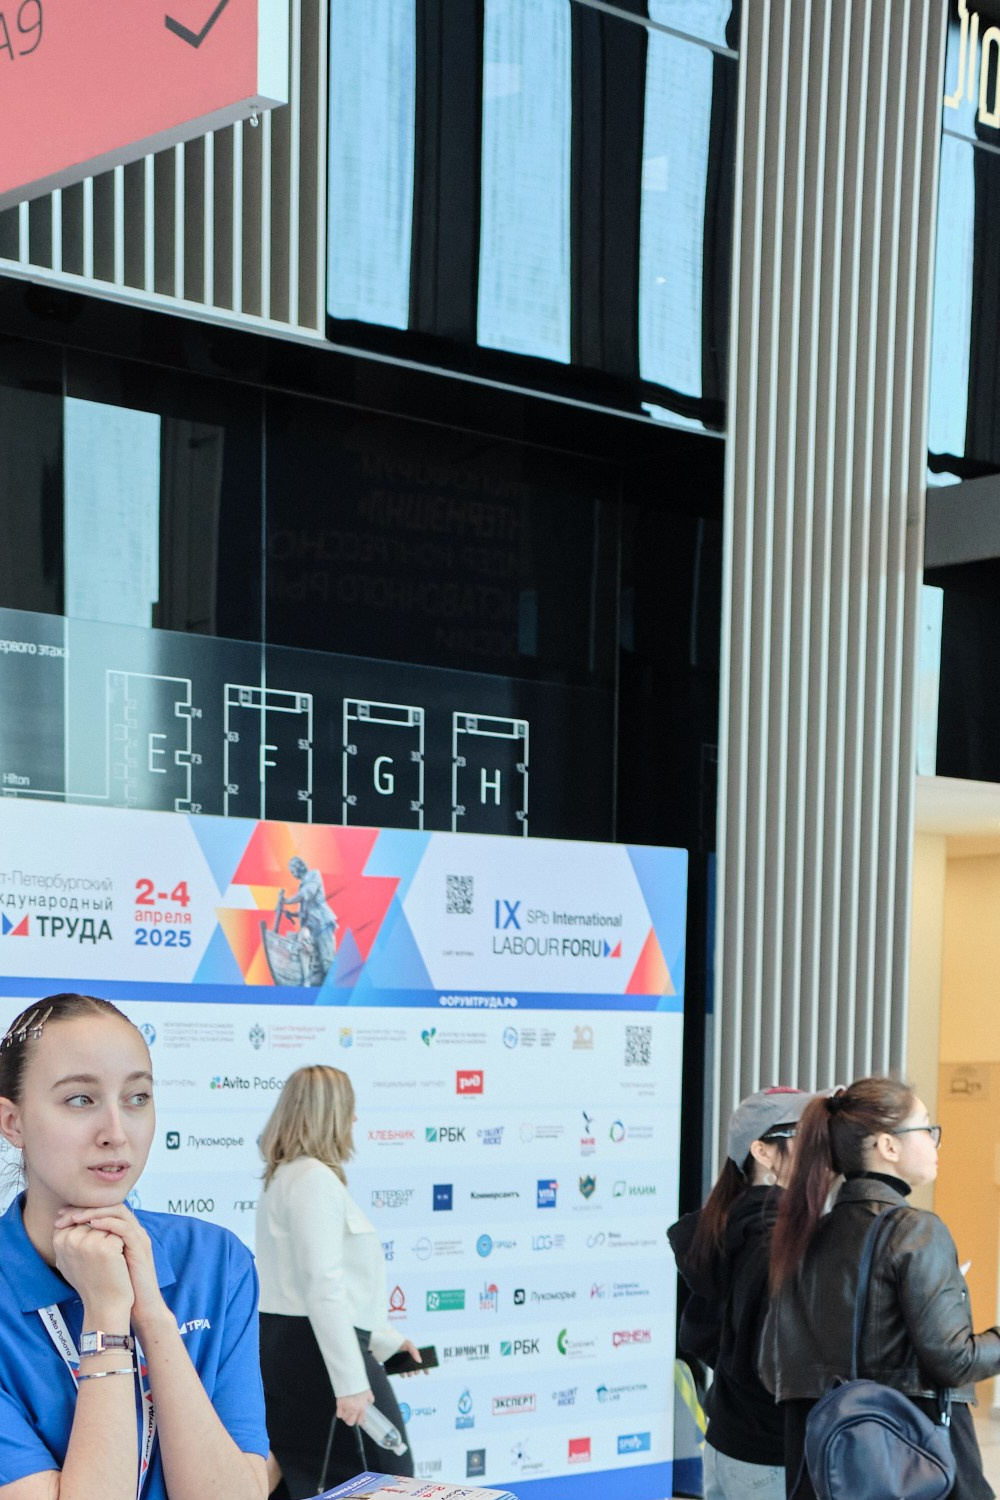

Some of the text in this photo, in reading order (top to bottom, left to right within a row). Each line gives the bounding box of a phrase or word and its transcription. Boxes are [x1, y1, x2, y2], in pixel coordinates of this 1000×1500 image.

[149, 733, 167, 773] E
[260, 745, 278, 782] F
[3, 773, 30, 785] Hilton
[373, 756, 394, 795] G
[481, 767, 501, 805] H
[135, 878, 191, 907] 2-4
[135, 909, 192, 927] апреля
[495, 900, 522, 930] IX
[526, 909, 622, 927] SPb International
[36, 915, 113, 944] ТРУДА
[135, 928, 191, 947] 2025
[492, 936, 559, 956] LABOUR
[222, 1076, 286, 1090] Avito Рабо
[187, 1135, 244, 1147] Лукоморье
[368, 1129, 415, 1140] ХЛЕБНИК
[439, 1127, 465, 1142] РБК
[48, 1313, 72, 1356] Avito Работа
[514, 1339, 540, 1355] РБК
[495, 1396, 533, 1408] ЭКСПЕРТ
